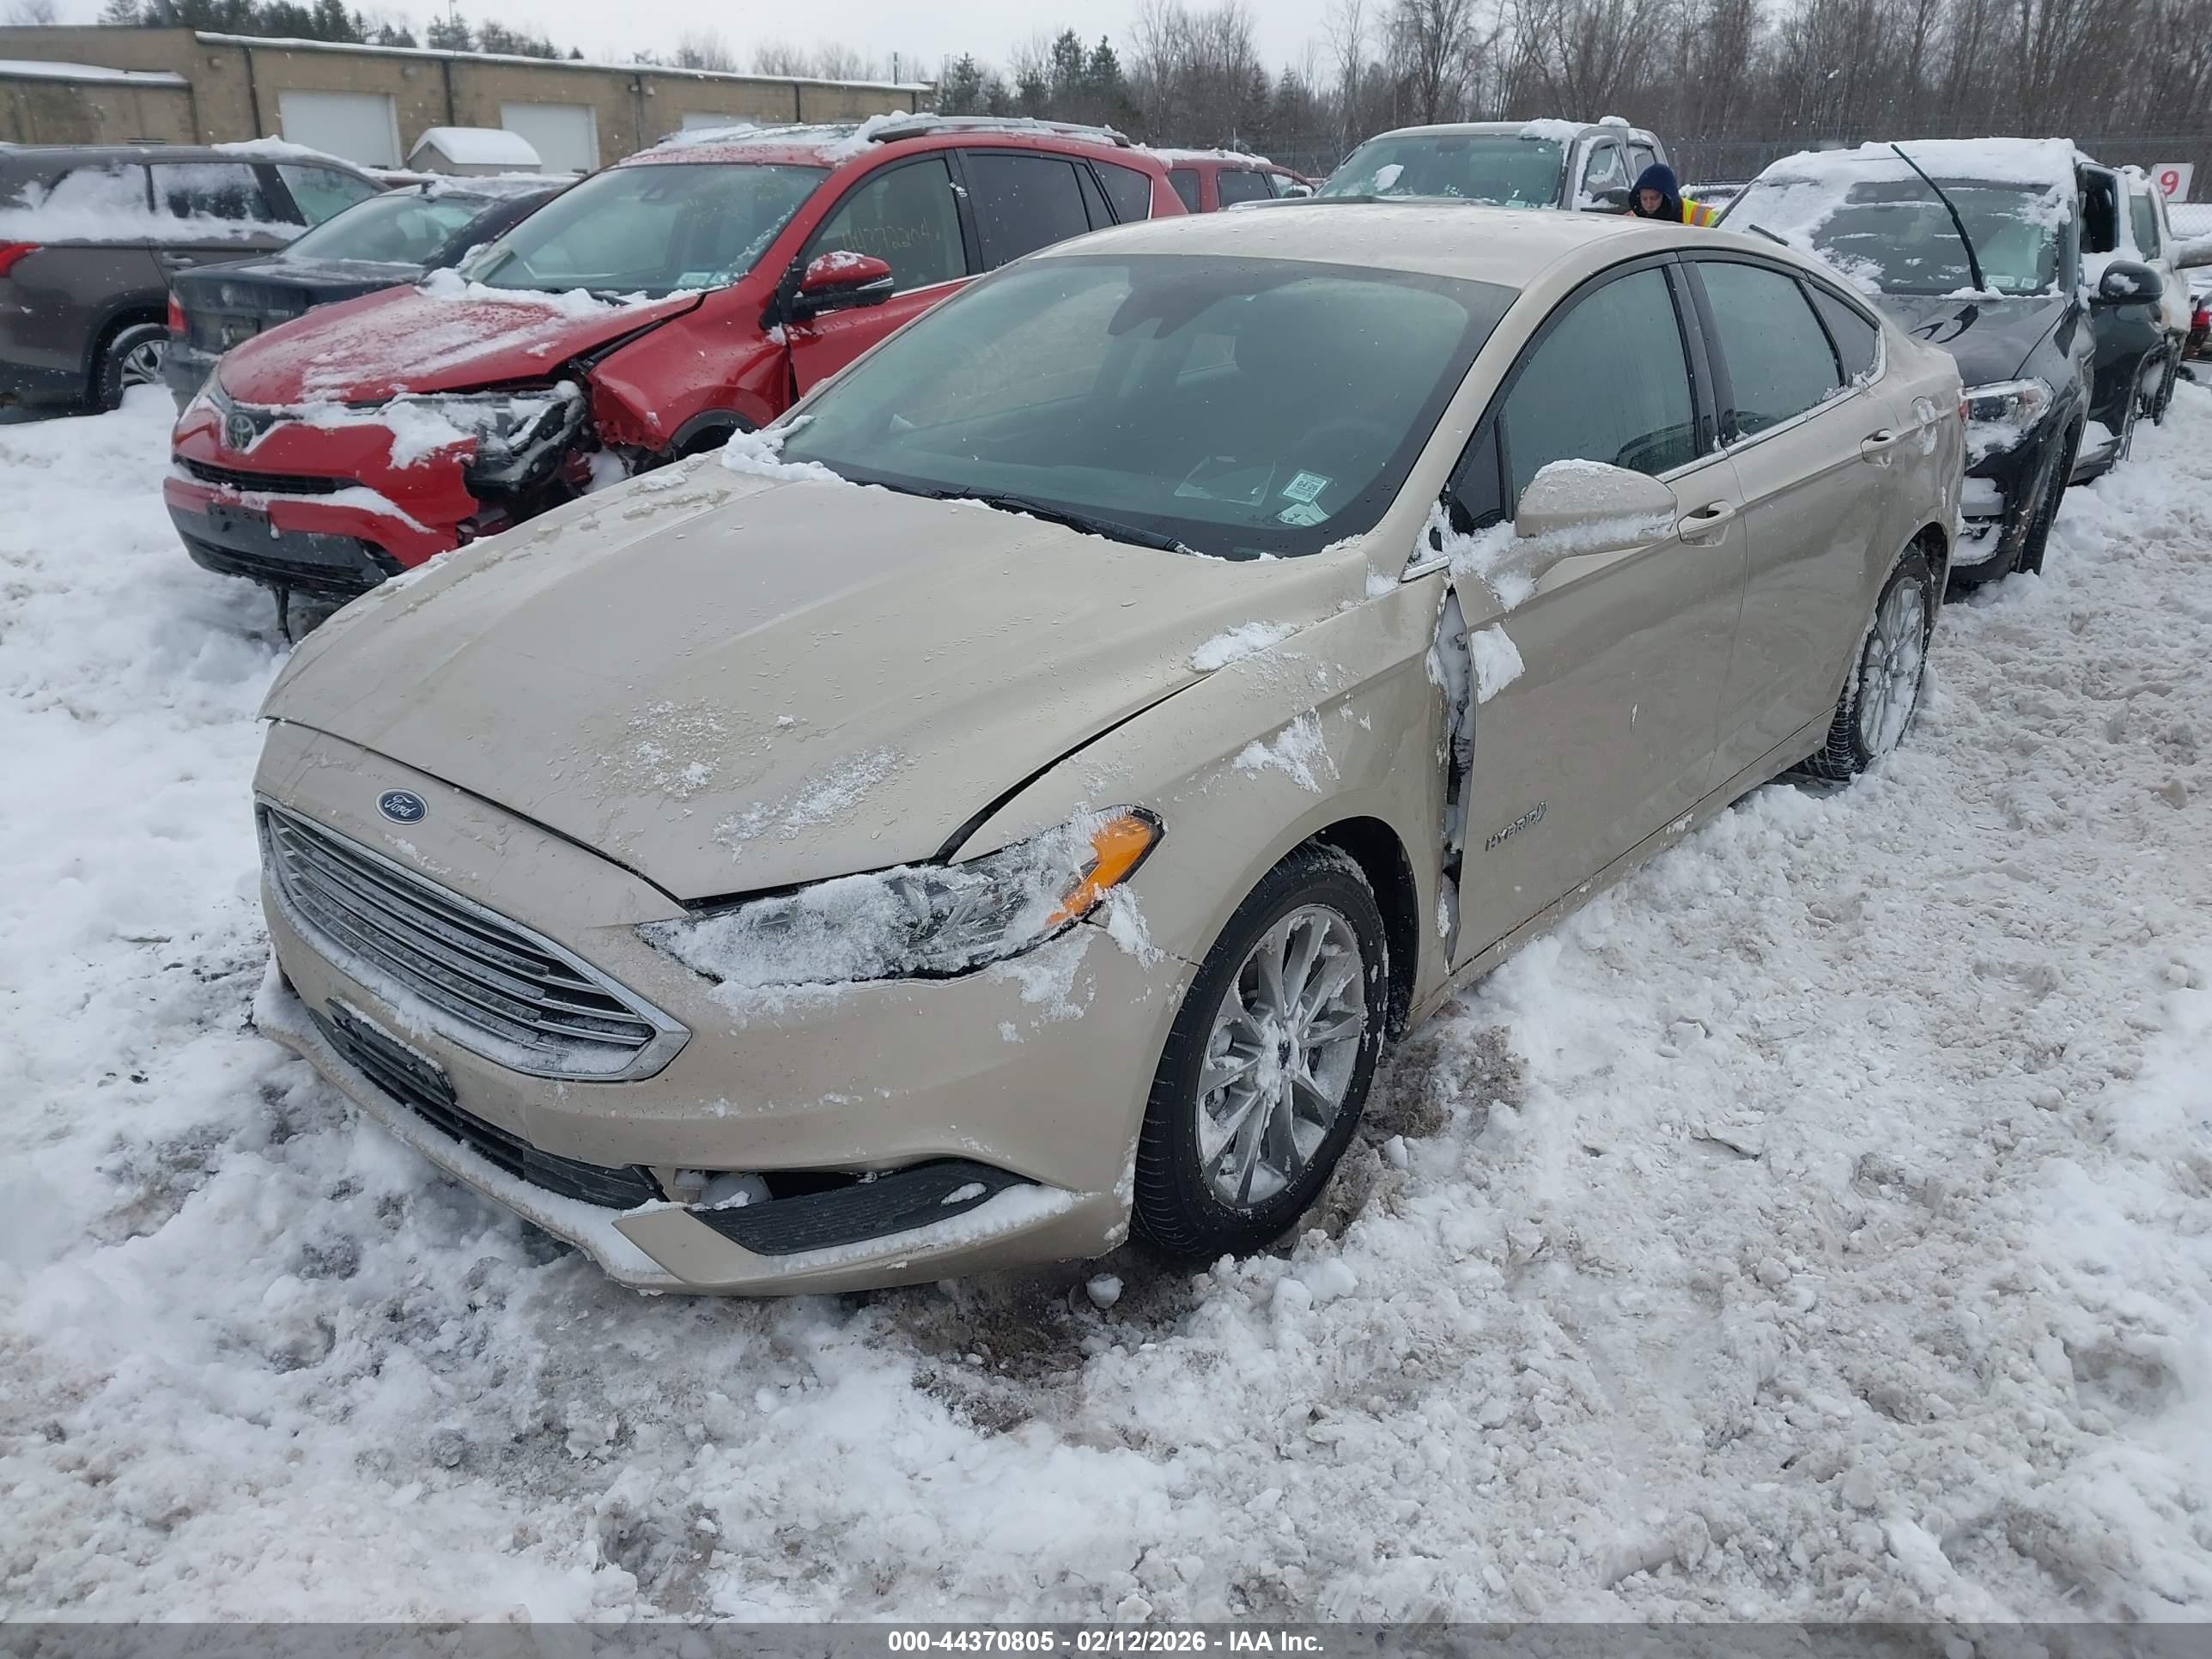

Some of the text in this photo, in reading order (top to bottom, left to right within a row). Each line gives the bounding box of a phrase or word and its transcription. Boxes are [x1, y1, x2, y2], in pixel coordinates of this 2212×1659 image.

[2160, 170, 2180, 196] 9
[384, 794, 417, 817] Ford
[1485, 799, 1547, 852] HYBRID
